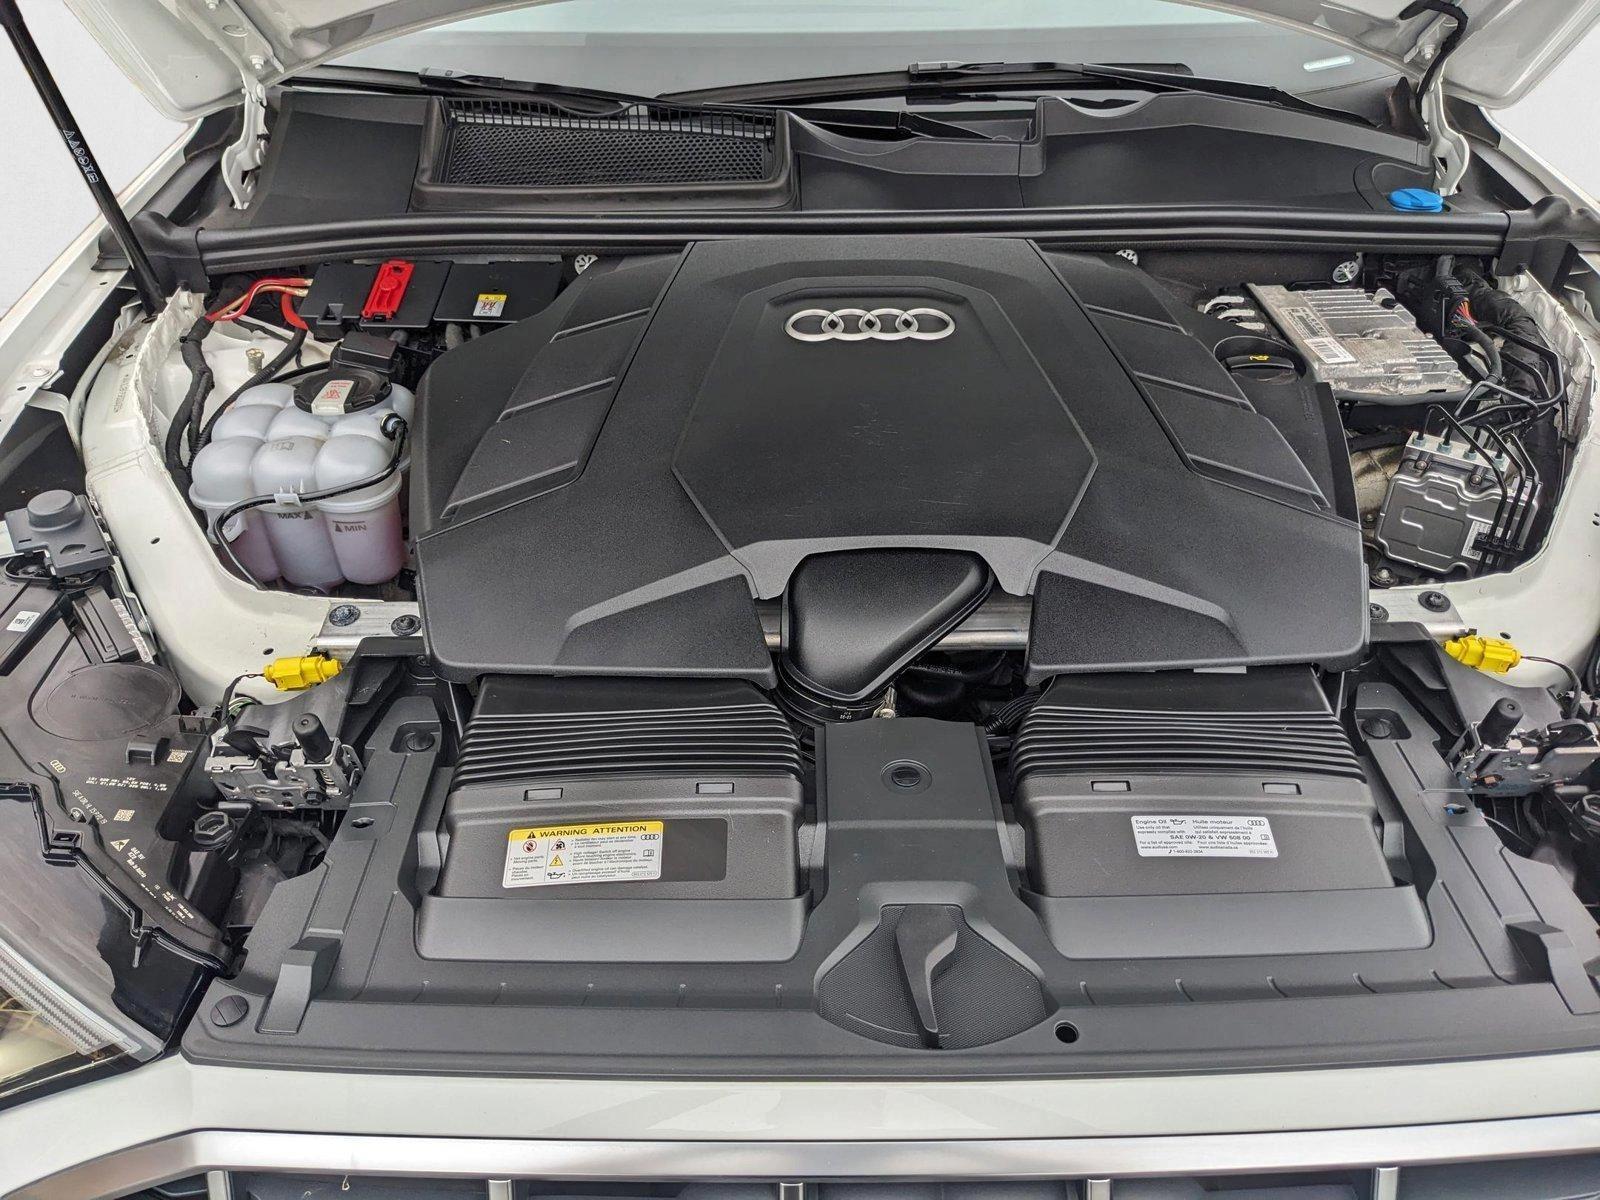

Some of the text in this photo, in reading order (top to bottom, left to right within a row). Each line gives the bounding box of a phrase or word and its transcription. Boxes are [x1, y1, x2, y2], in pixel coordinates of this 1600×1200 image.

[277, 512, 301, 520] MAX
[344, 524, 367, 532] MIN
[540, 825, 647, 837] WARNING ATTENTION
